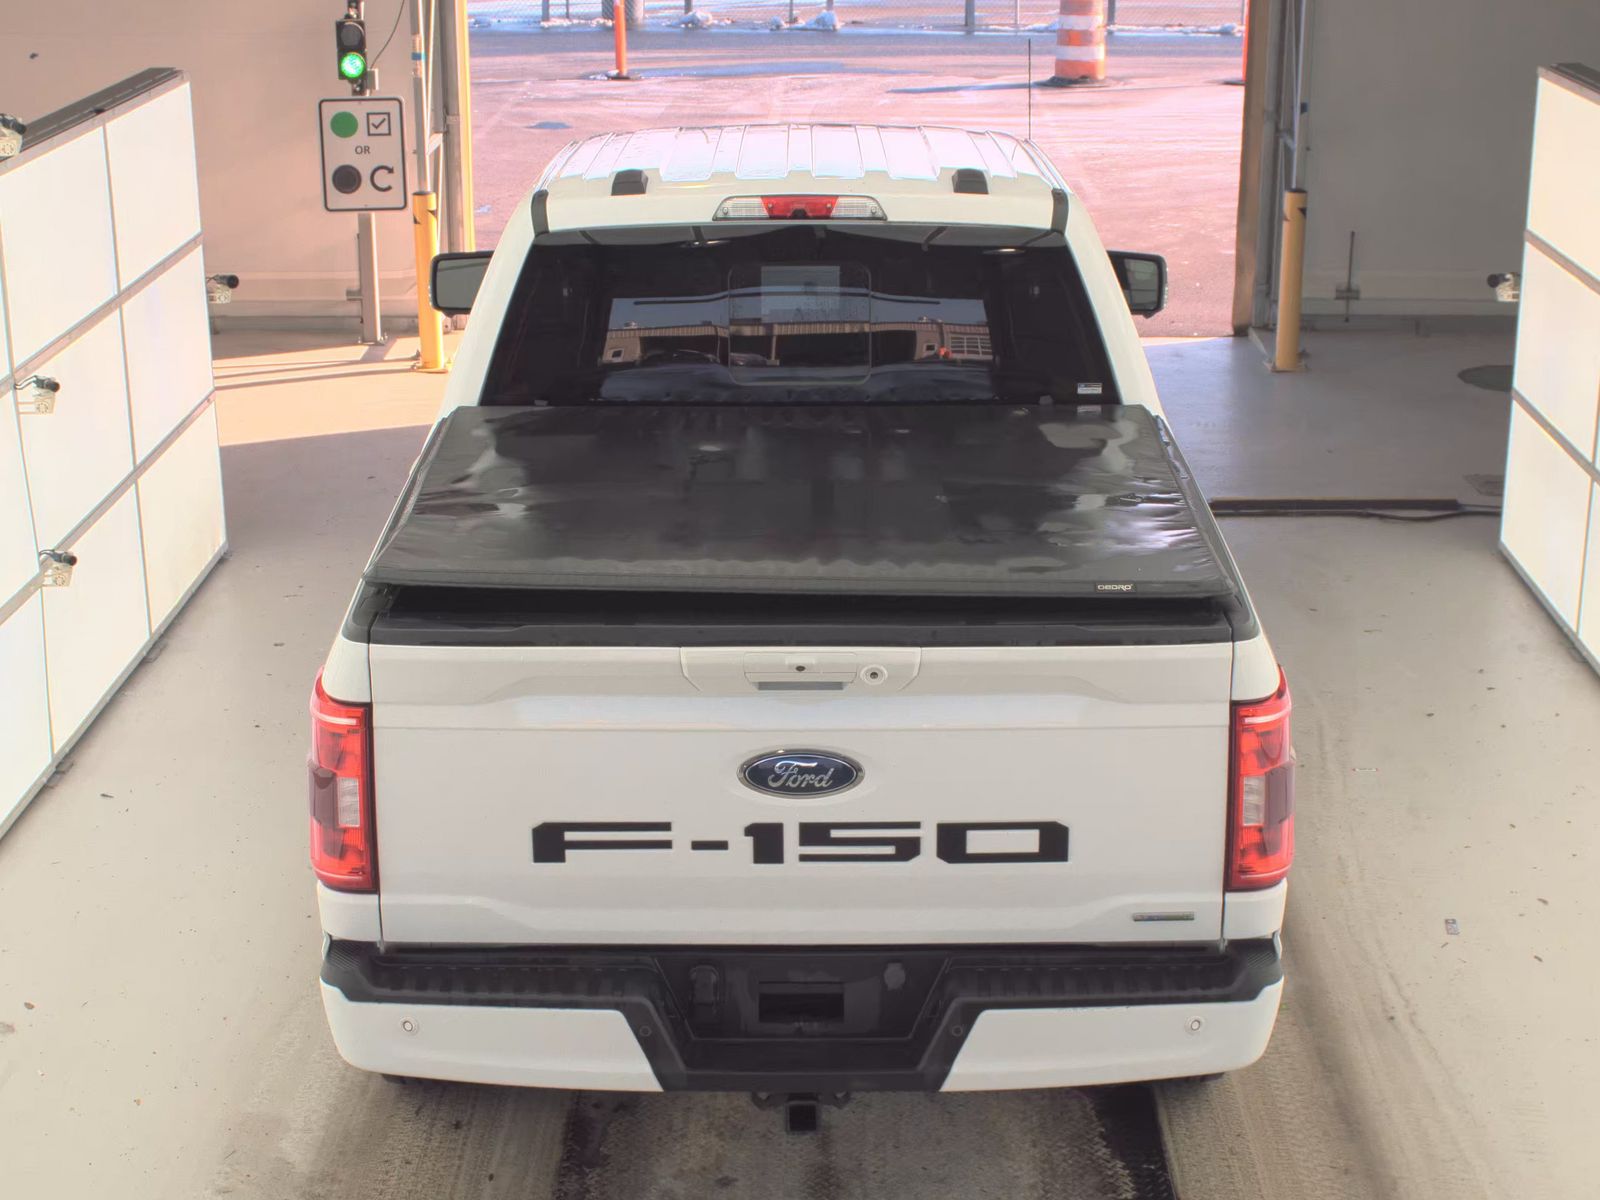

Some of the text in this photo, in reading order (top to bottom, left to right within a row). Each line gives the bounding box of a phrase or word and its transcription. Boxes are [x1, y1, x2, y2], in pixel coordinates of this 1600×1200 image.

[354, 145, 371, 155] OR
[767, 760, 835, 788] Ford
[532, 821, 1069, 865] F-150
